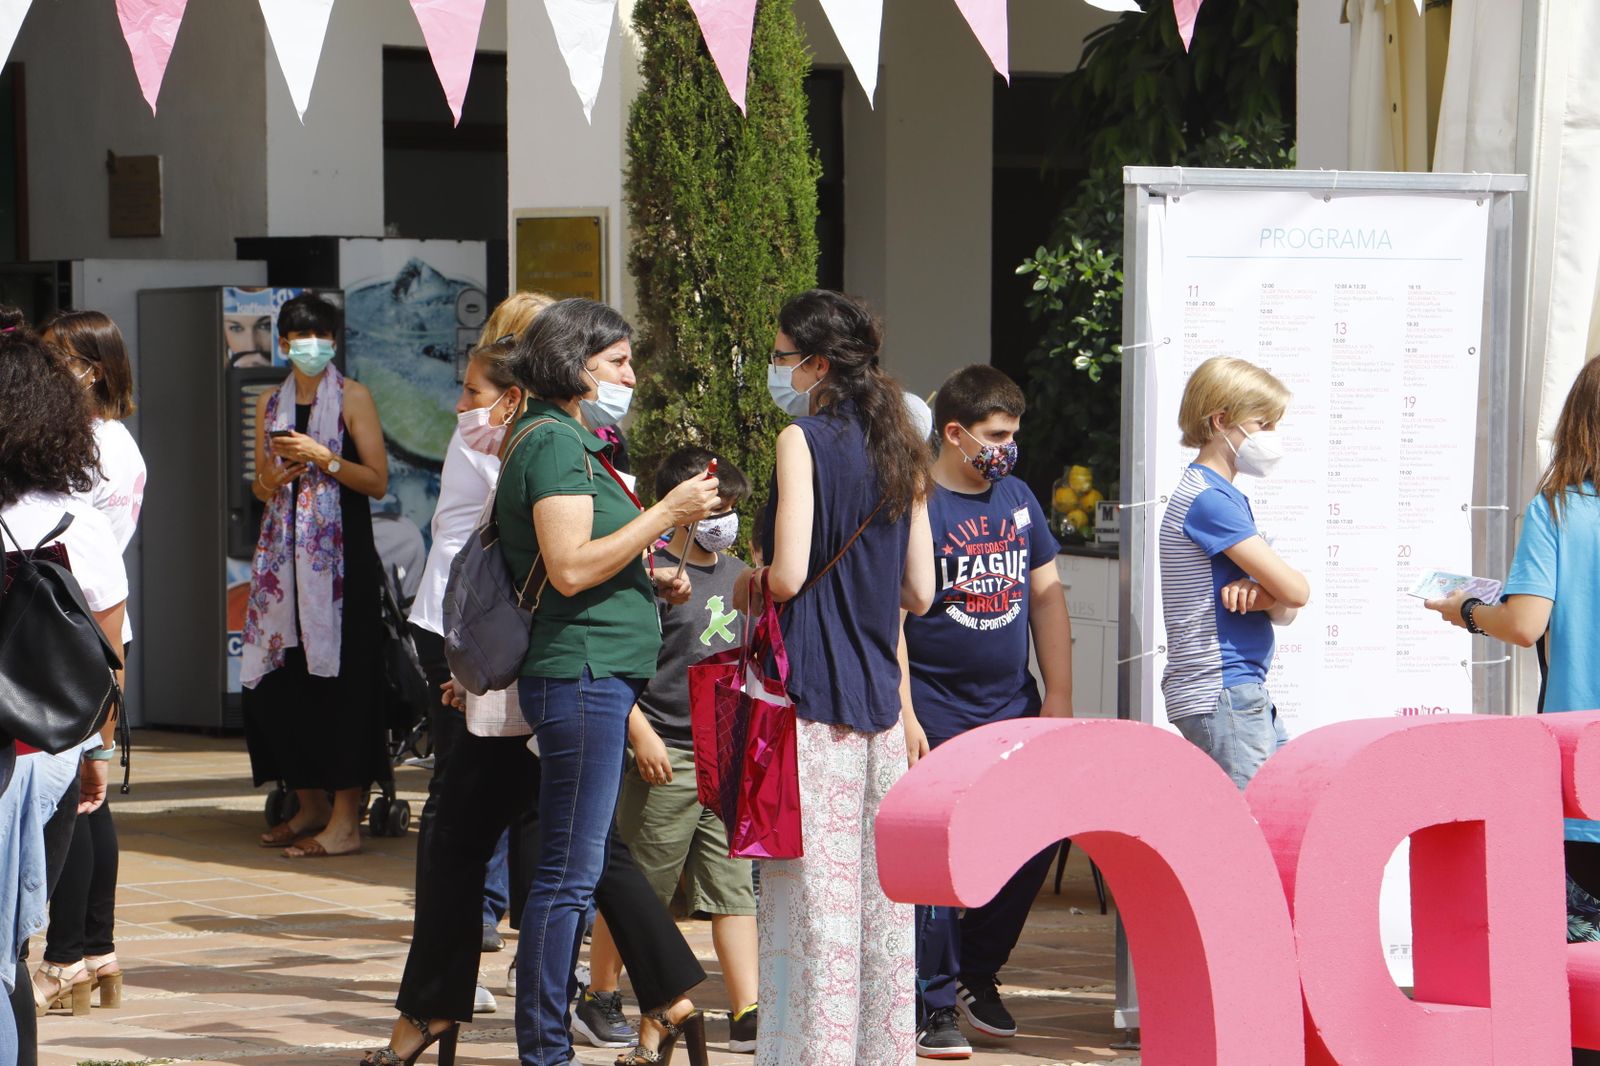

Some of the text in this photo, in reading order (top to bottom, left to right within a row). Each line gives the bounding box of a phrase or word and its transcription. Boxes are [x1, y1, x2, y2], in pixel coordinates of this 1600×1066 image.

[1259, 228, 1392, 249] PROGRAMA
[1187, 284, 1199, 298] 11
[1334, 321, 1347, 335] 13
[1403, 395, 1416, 409] 19
[1327, 503, 1341, 516] 15
[948, 516, 1016, 548] LIVE IS
[1327, 545, 1339, 558] 17
[1397, 544, 1411, 558] 20
[941, 549, 1028, 591] LEAGUE
[973, 577, 1003, 594] CITY
[966, 590, 1010, 613] BRKLN
[946, 602, 1022, 631] ORIGINAL SPORTSWEAR
[1326, 624, 1339, 637] 18
